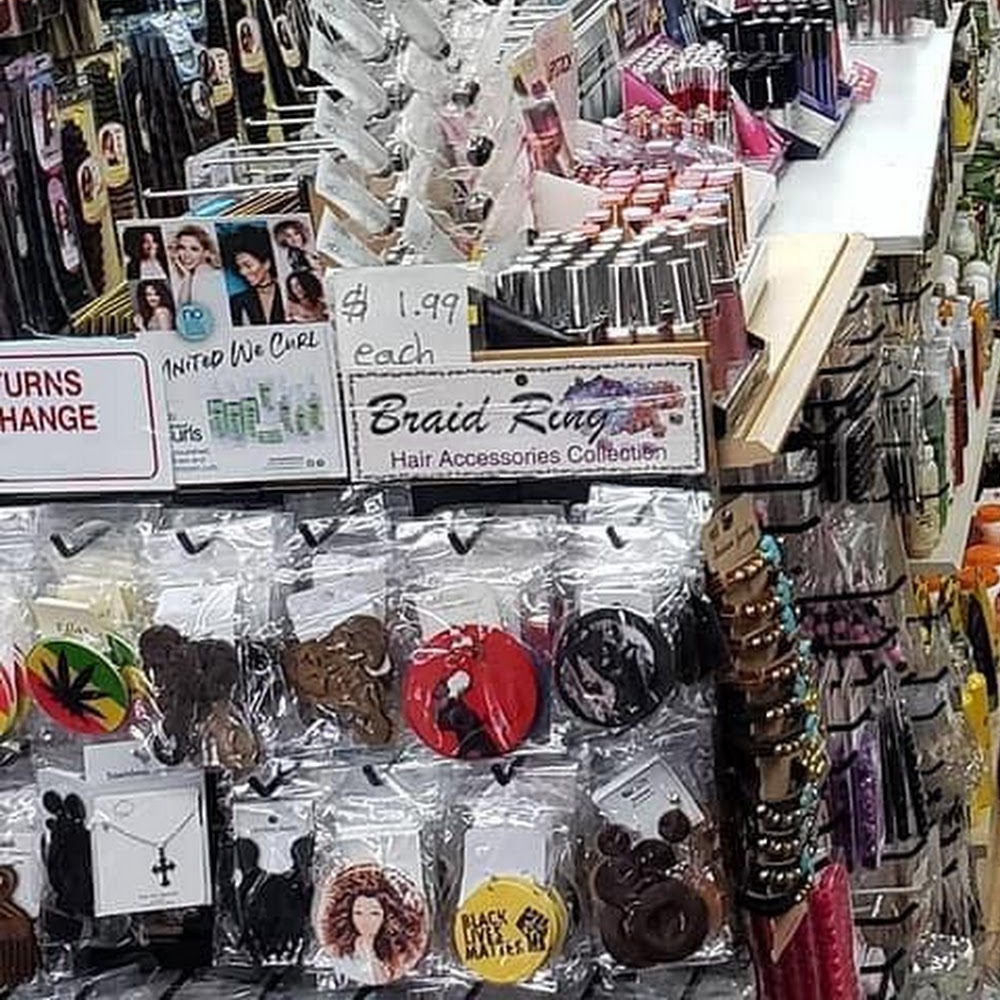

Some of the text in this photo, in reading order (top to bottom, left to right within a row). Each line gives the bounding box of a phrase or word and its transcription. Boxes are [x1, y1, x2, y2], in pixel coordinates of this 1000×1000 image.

[341, 283, 459, 325] $ 1.99
[354, 331, 434, 365] each
[0, 369, 82, 397] URNS
[367, 392, 609, 444] Braid Ring
[391, 443, 667, 469] Hair Accessories Collection
[461, 908, 508, 929] BLACK
[463, 926, 503, 945] LIVES
